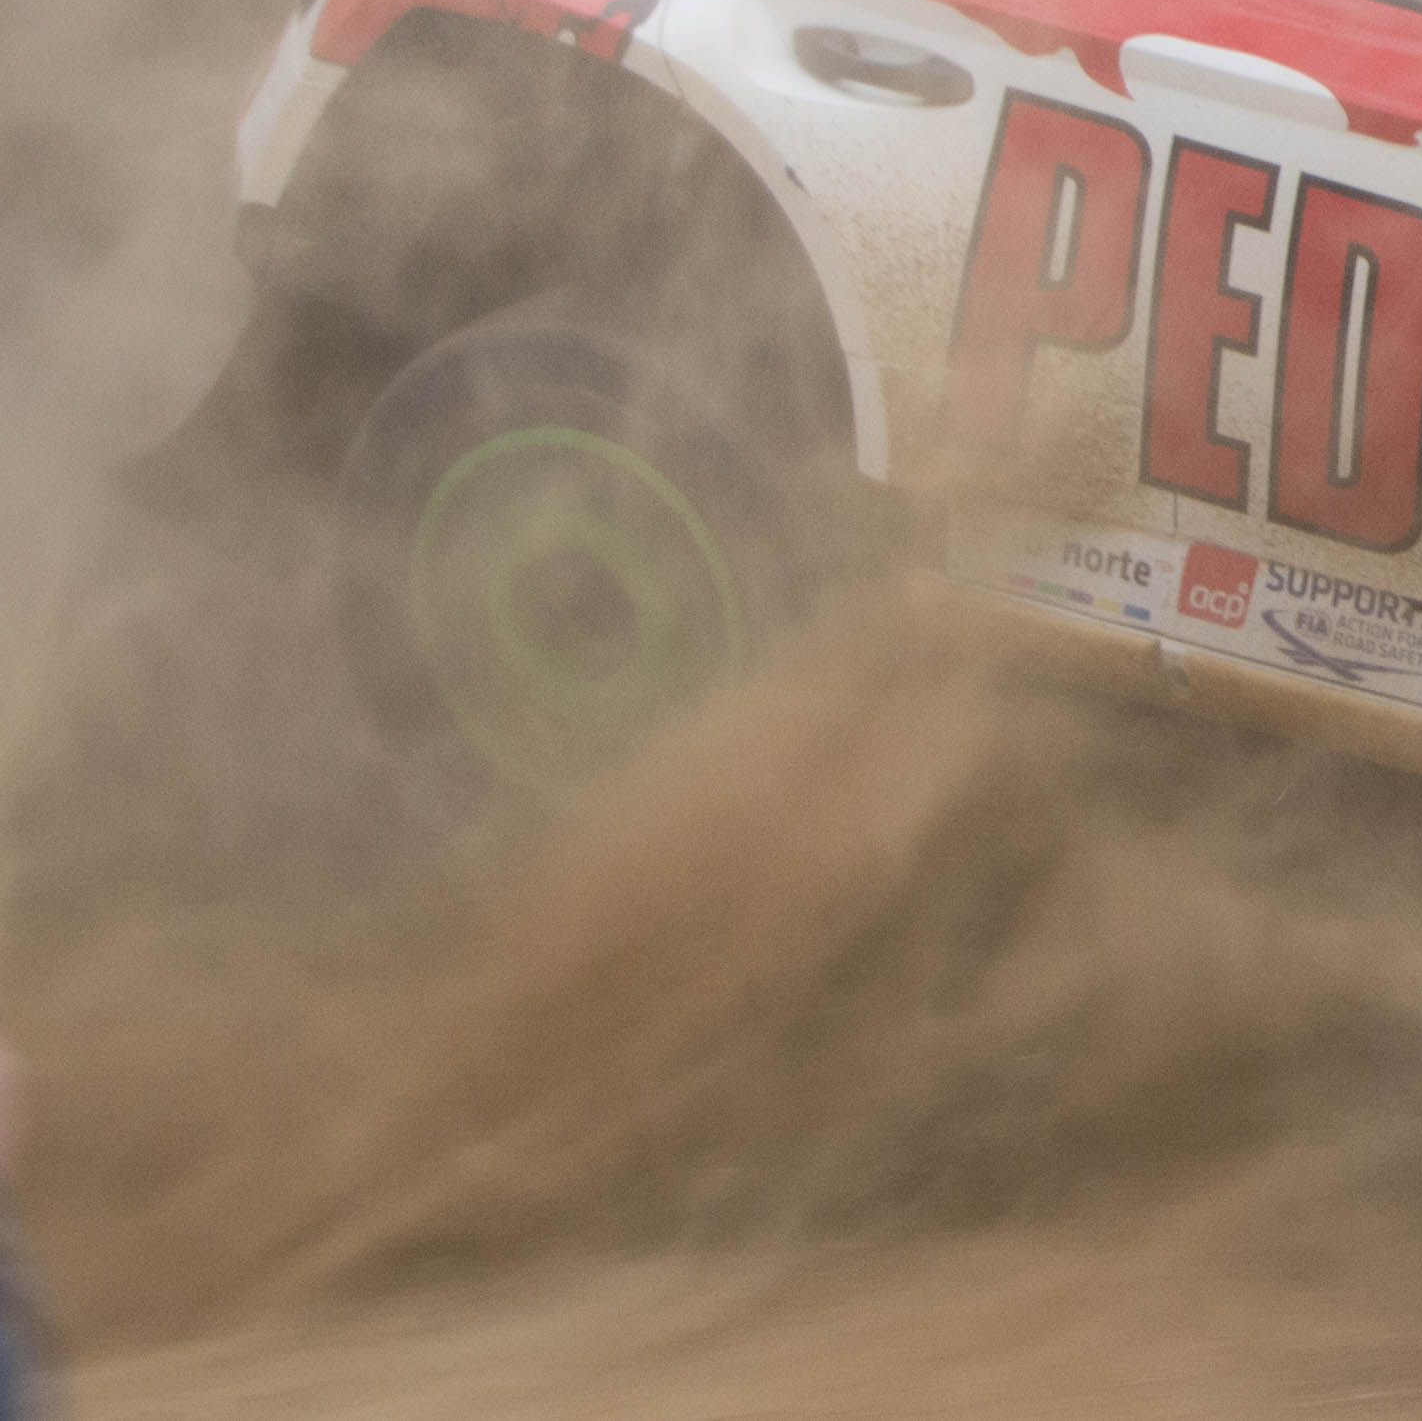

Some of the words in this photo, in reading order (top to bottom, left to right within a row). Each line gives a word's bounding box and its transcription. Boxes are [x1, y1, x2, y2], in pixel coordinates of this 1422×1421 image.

[1063, 541, 1152, 588] norte
[1189, 584, 1247, 621] acp
[1332, 632, 1376, 655] ROAD
[1336, 616, 1392, 642] ACTION
